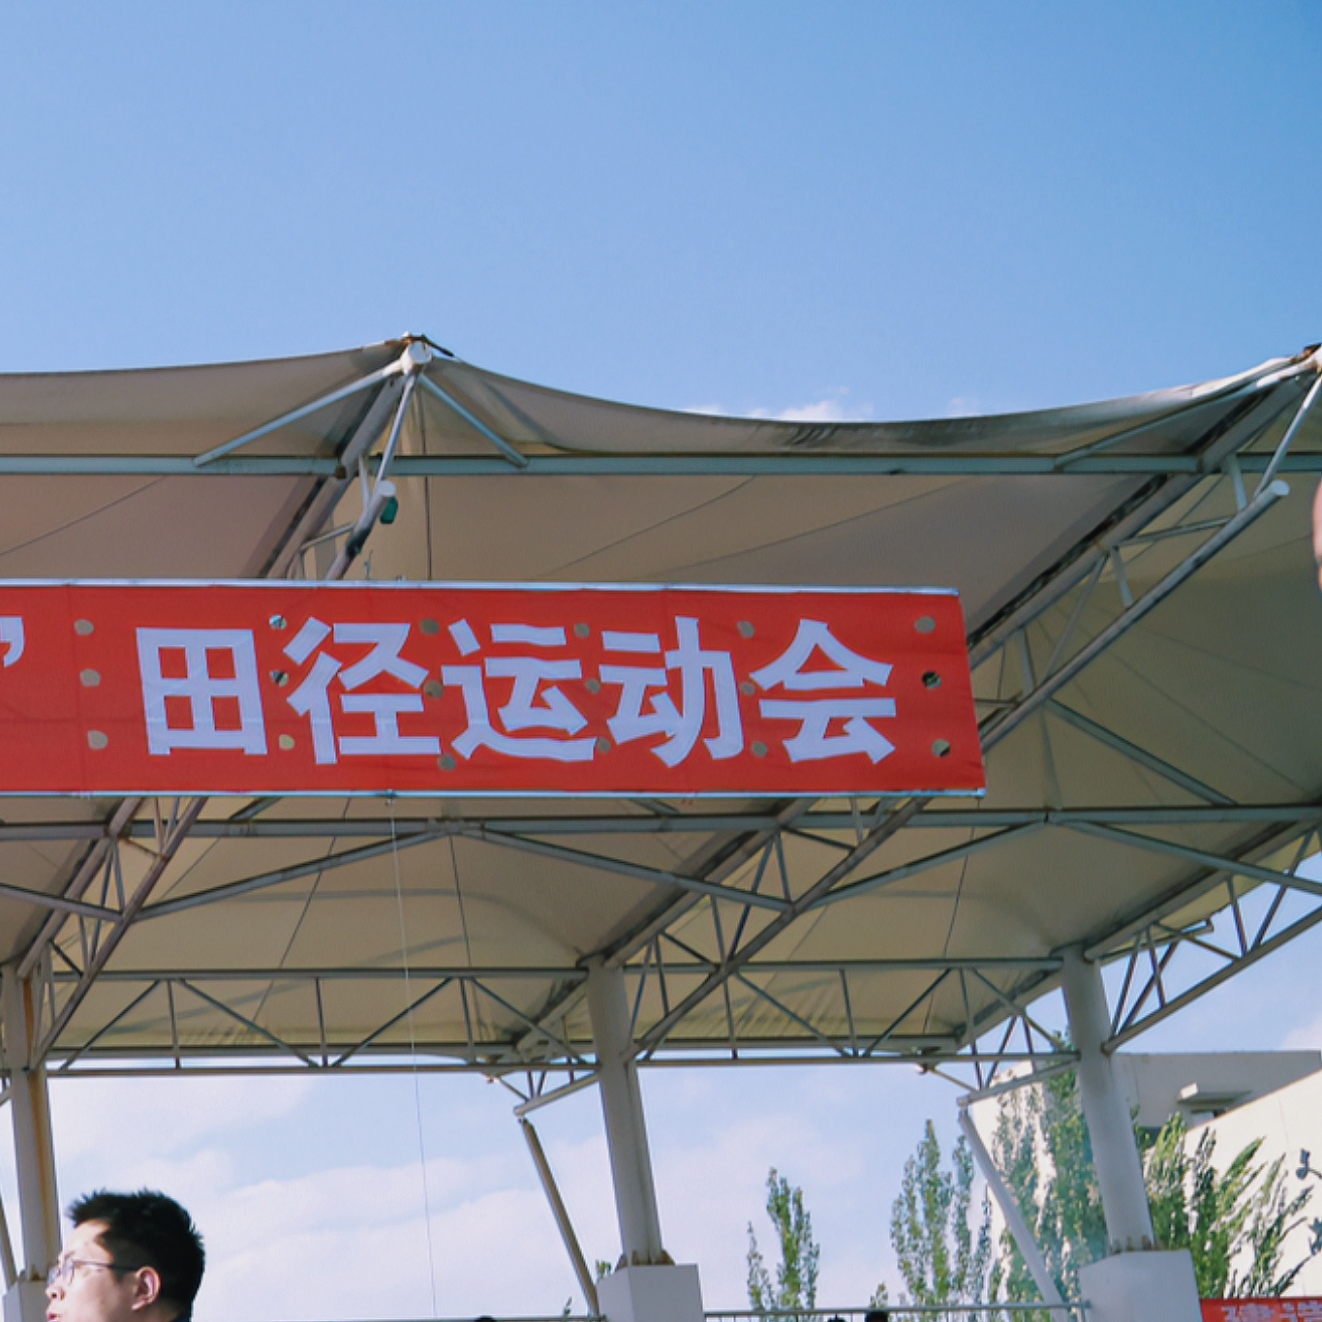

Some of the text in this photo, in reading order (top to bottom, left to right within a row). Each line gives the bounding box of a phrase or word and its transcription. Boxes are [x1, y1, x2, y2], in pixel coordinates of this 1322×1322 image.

[135, 615, 897, 768] 田径运动会
